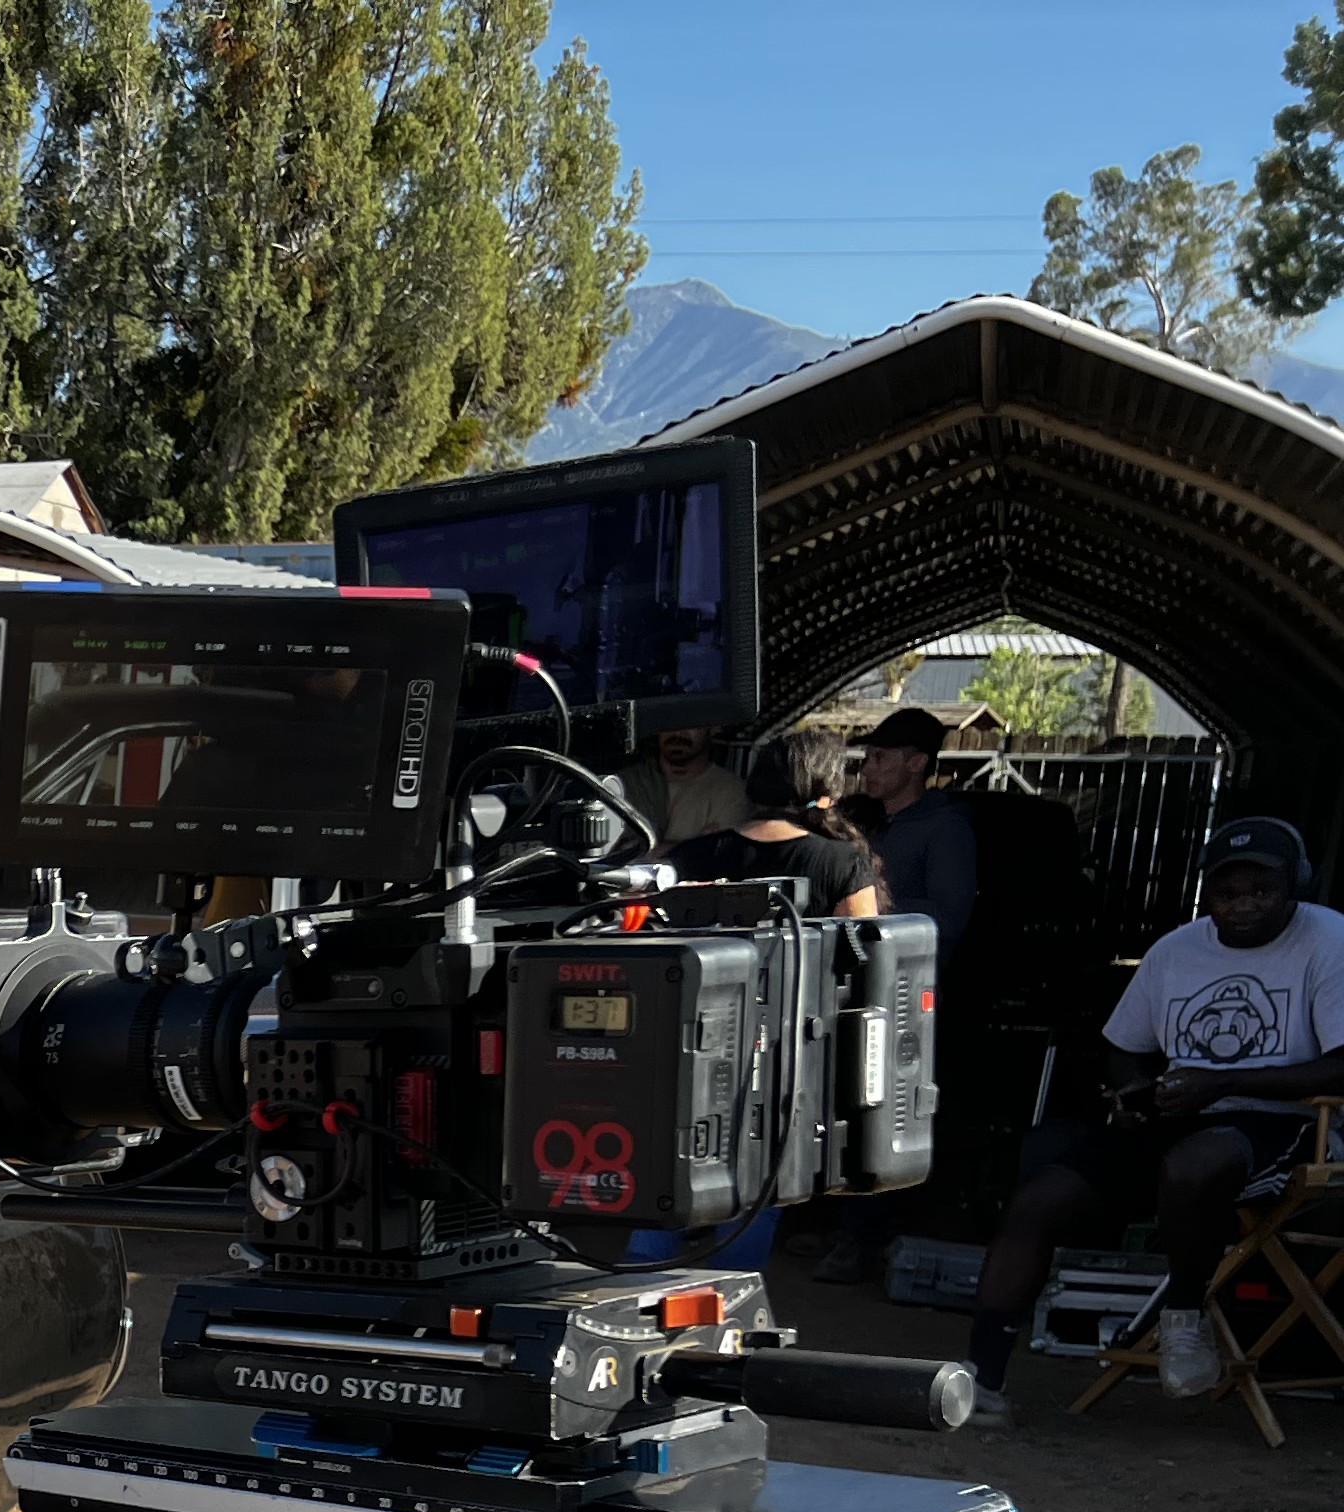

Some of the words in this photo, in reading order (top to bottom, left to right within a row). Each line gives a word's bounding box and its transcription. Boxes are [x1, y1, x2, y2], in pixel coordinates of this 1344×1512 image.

[558, 964, 621, 982] SWIT
[533, 1120, 634, 1213] 98
[233, 1367, 330, 1395] TANGO
[340, 1377, 464, 1409] SYSTEM
[587, 1356, 619, 1392] AR
[95, 1457, 108, 1467] 160
[124, 1462, 138, 1472] 140
[153, 1466, 167, 1476] 120
[183, 1470, 198, 1480] 100
[312, 1488, 324, 1498] 20
[379, 1498, 392, 1508] 20
